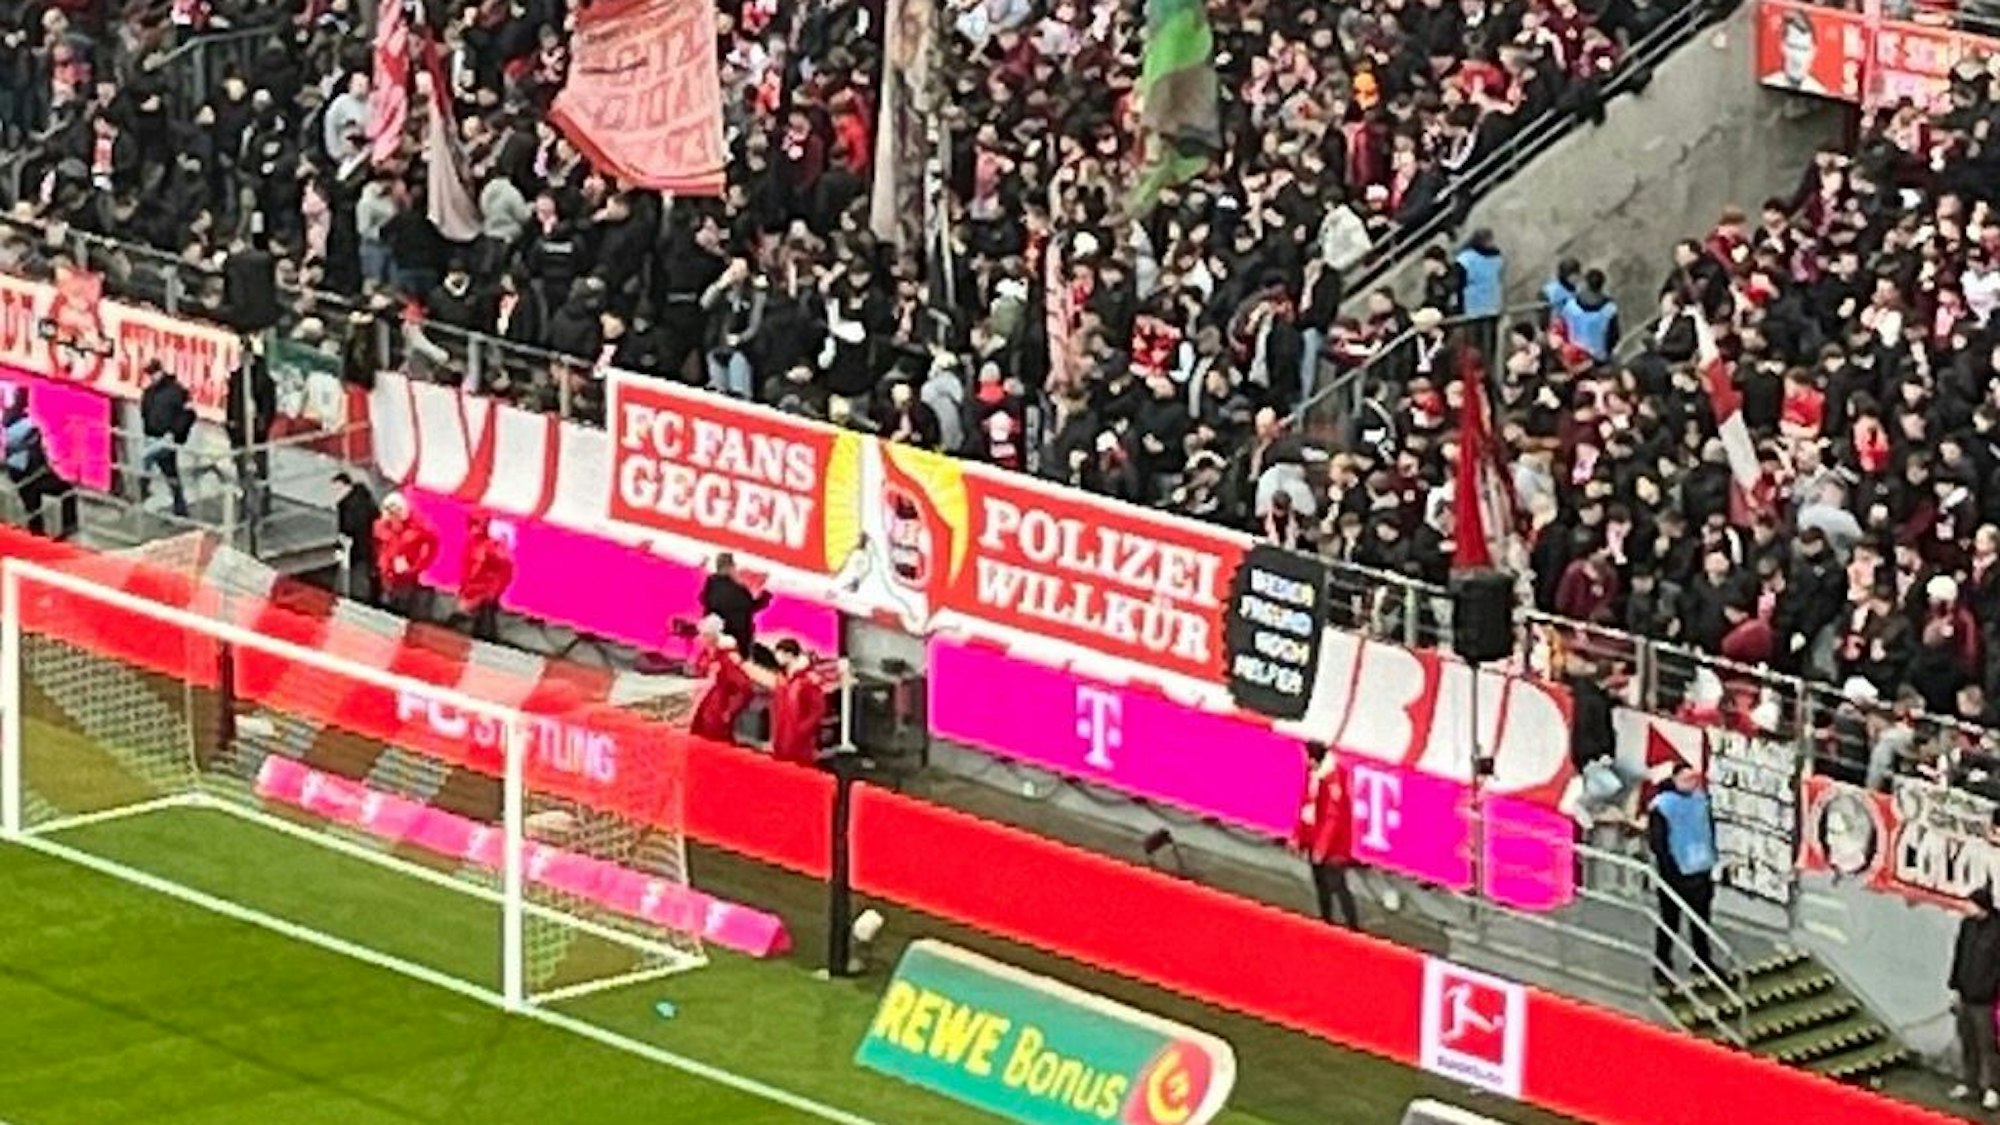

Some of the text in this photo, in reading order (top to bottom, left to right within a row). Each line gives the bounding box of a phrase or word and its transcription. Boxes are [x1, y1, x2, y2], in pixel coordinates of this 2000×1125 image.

[621, 402, 684, 457] FC
[691, 416, 816, 491] FANS
[620, 455, 814, 549] GEGEN
[979, 495, 1222, 606] POLIZEI
[976, 556, 1210, 663] WILLKÜR
[873, 978, 1128, 1119] REWE Bonus
